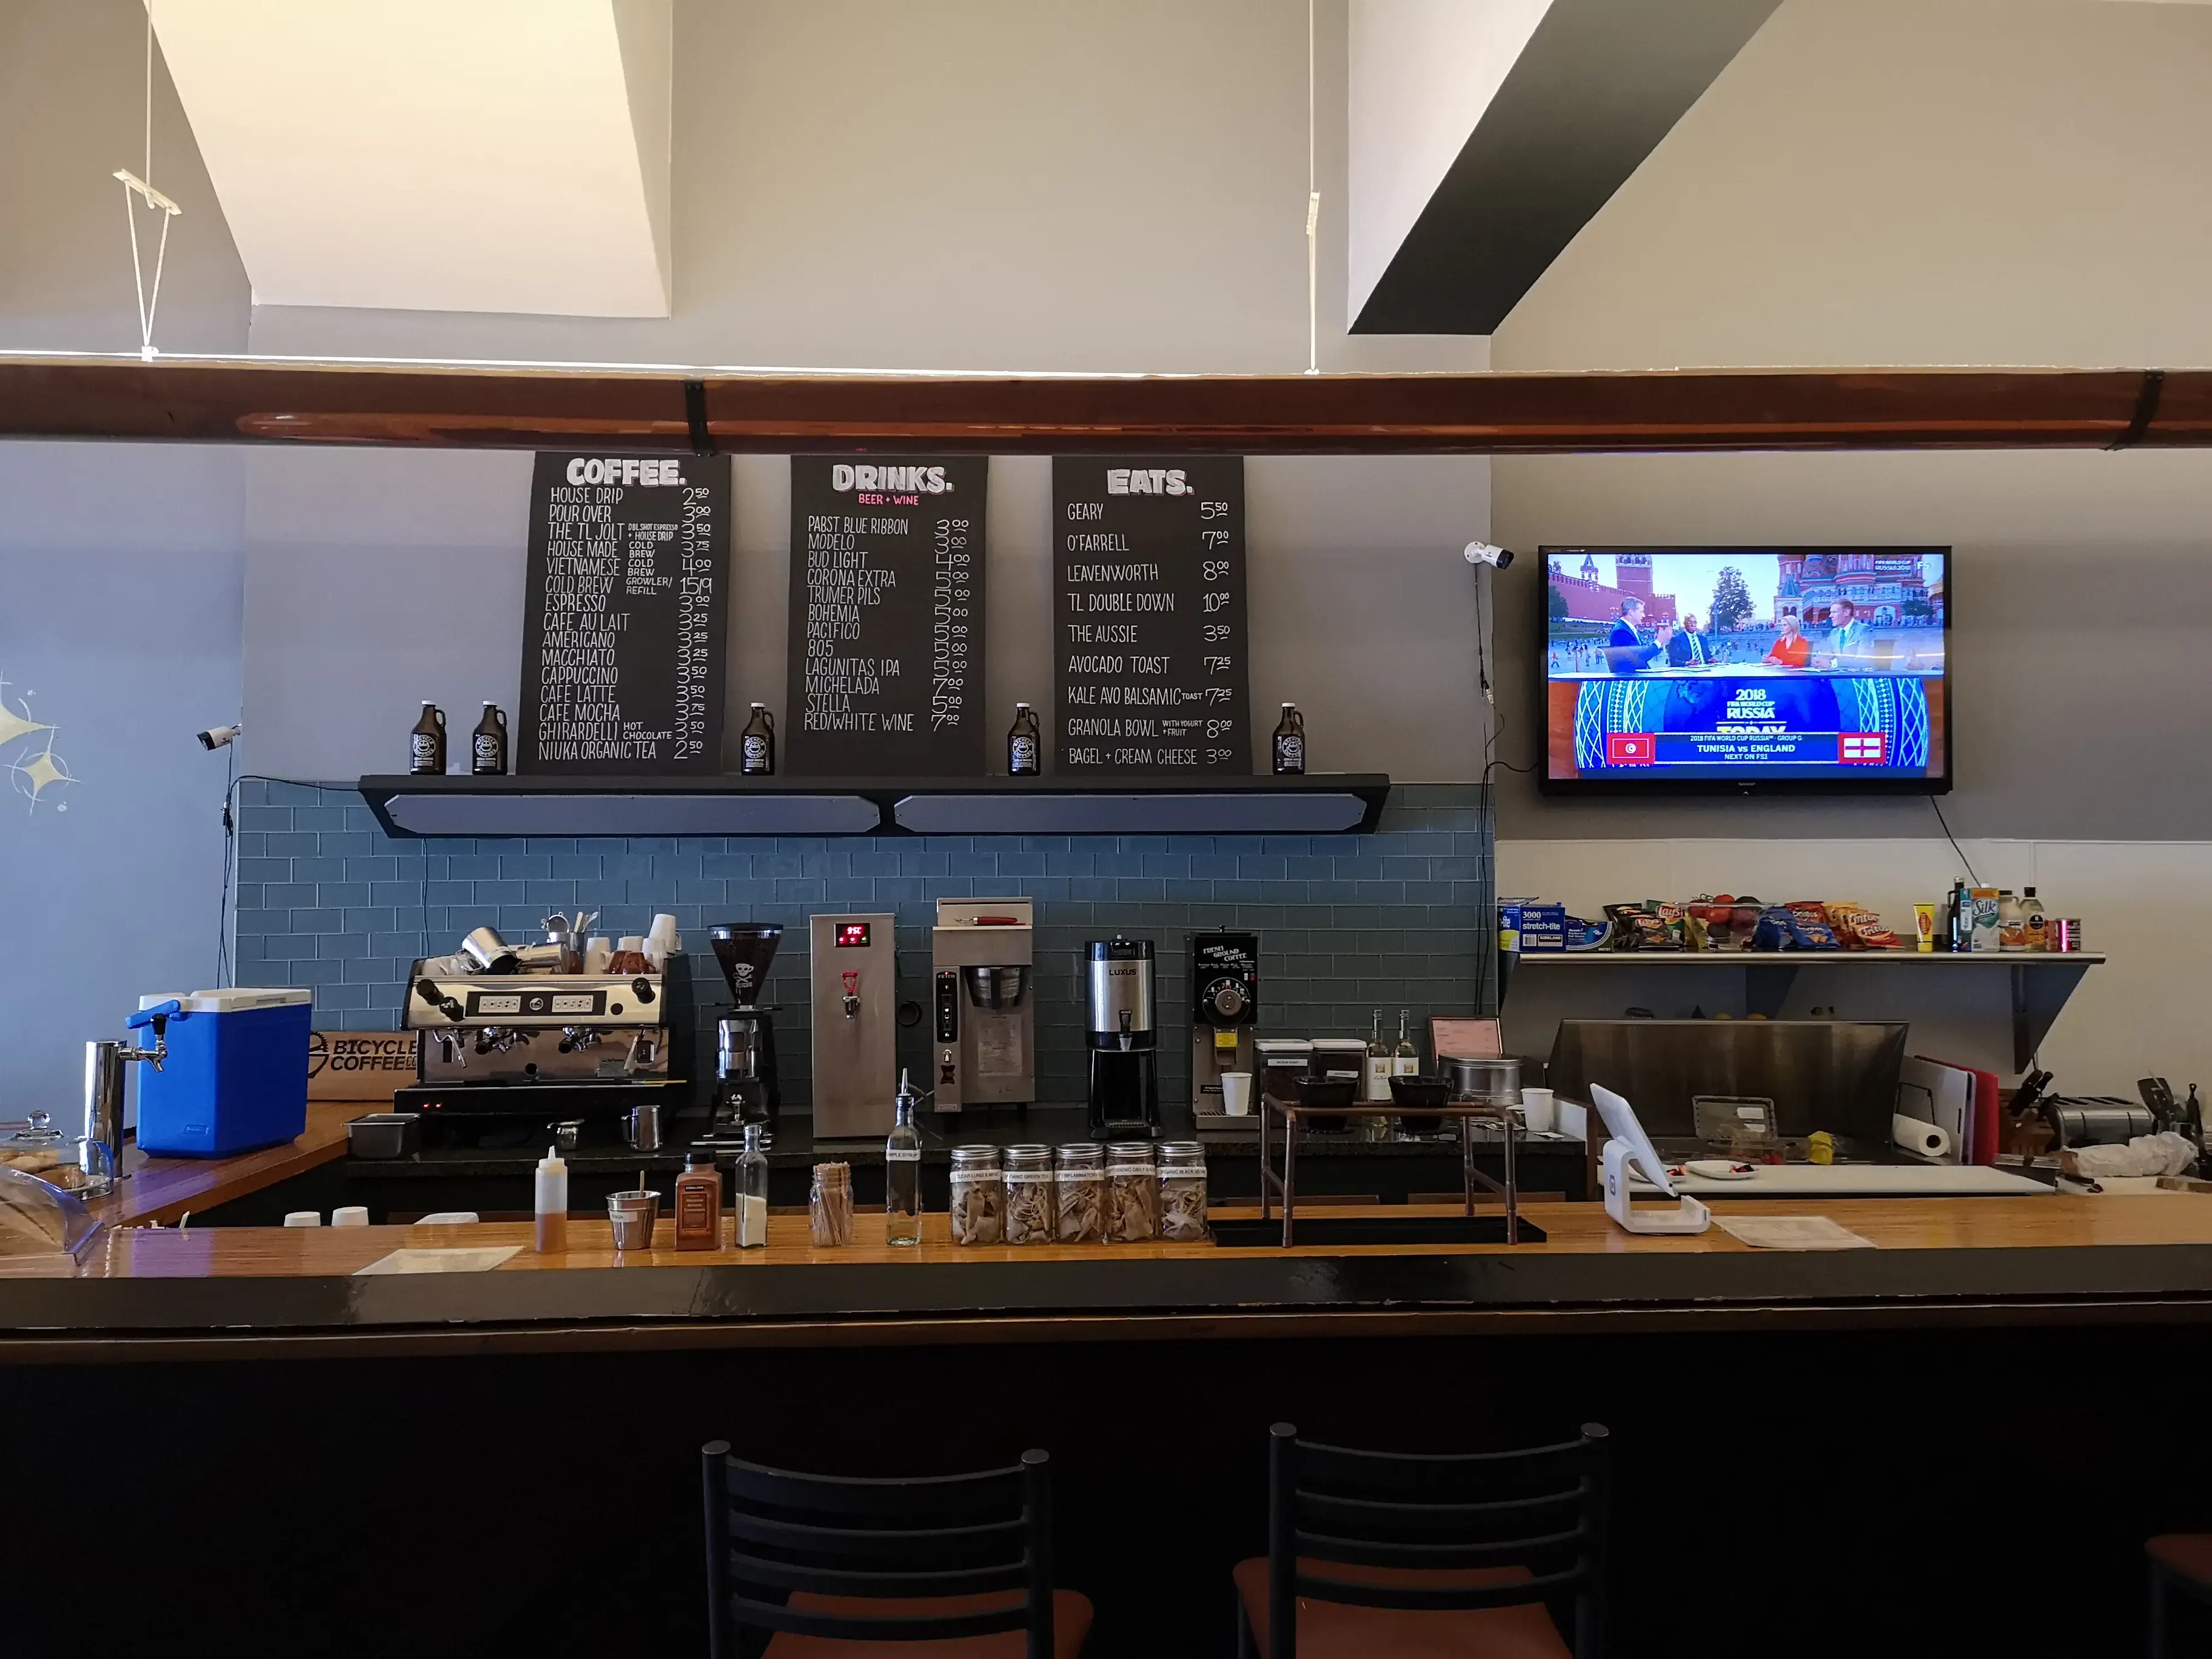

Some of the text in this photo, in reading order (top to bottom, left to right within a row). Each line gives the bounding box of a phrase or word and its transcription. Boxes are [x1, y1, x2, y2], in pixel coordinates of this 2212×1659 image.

[566, 458, 687, 486] COFFEE.
[833, 464, 954, 494] DRINKS.
[1107, 469, 1195, 495] EATS.
[551, 488, 623, 504] HOUSE DRIP
[859, 494, 919, 505] BEER WINE
[549, 505, 611, 522] POUR OVER
[1067, 503, 1104, 520] GEARY
[548, 522, 625, 540] THE TL JOLT
[808, 516, 908, 535] PABST BLUE RIBBON
[635, 532, 657, 540] HOUSE
[658, 532, 673, 541] DRIP
[808, 534, 854, 550] MODELO
[1067, 534, 1129, 551] O'FARRELL
[547, 541, 618, 557] HOUSE MADE
[629, 549, 655, 558] BREW
[547, 557, 621, 576] VIETNAMESE
[808, 551, 868, 569] BUD LIGHT
[807, 569, 896, 587] CORONA EXTRA
[1067, 565, 1158, 581] LEAVENWORTH
[546, 577, 574, 594] COLD
[578, 577, 613, 594] BREW
[626, 577, 672, 588] GROWLER/
[546, 594, 606, 612] ESPRESSO
[807, 586, 854, 604] TRUMER
[858, 588, 880, 605] PILS
[1067, 593, 1174, 611] TL DOUBLE DOWN
[544, 612, 630, 631] CAFE AU LAIT
[808, 604, 859, 622] BOHEMIA
[808, 622, 860, 639] PACIFICO
[1067, 625, 1091, 642] THE
[1096, 625, 1138, 642] AUSSIE
[542, 631, 615, 648] AMERICANO
[808, 639, 833, 657] 805
[542, 649, 615, 666] MACCHIATO
[1068, 655, 1170, 674] AVOCADO TOAST
[541, 667, 618, 684] CAPPUCCINO
[806, 658, 900, 677] LAGUNITAS IPA
[540, 685, 616, 703] CAFE LATTE
[806, 676, 879, 695] MICHELADA
[805, 694, 850, 712] STELLA
[1068, 687, 1096, 704] KALE
[1100, 688, 1121, 704] AVO
[1125, 688, 1181, 705] BALSAMIC
[1735, 689, 1766, 700] 2018
[540, 704, 620, 722] CAFE MOCHA
[1727, 708, 1775, 719] RUSSIA
[805, 713, 914, 731] RED/WHITE WINE
[1068, 719, 1121, 736] GRANOLA
[1125, 720, 1159, 737] BOWL
[539, 722, 617, 740] GHIRARDELLI
[623, 731, 672, 740] CHOCOLATE
[581, 742, 631, 759] ORGANIC
[633, 742, 656, 759] TEA
[1069, 748, 1102, 763] BAGEL
[1115, 749, 1151, 764] CREAM
[1157, 749, 1198, 764] CHEESE
[1972, 900, 1996, 916] Silk
[1203, 945, 1224, 954] FRESH
[1213, 948, 1239, 957] GROUND
[1224, 953, 1247, 961] COFFEE
[333, 1040, 417, 1054] BICYCLE
[331, 1056, 404, 1070] COFFEE
